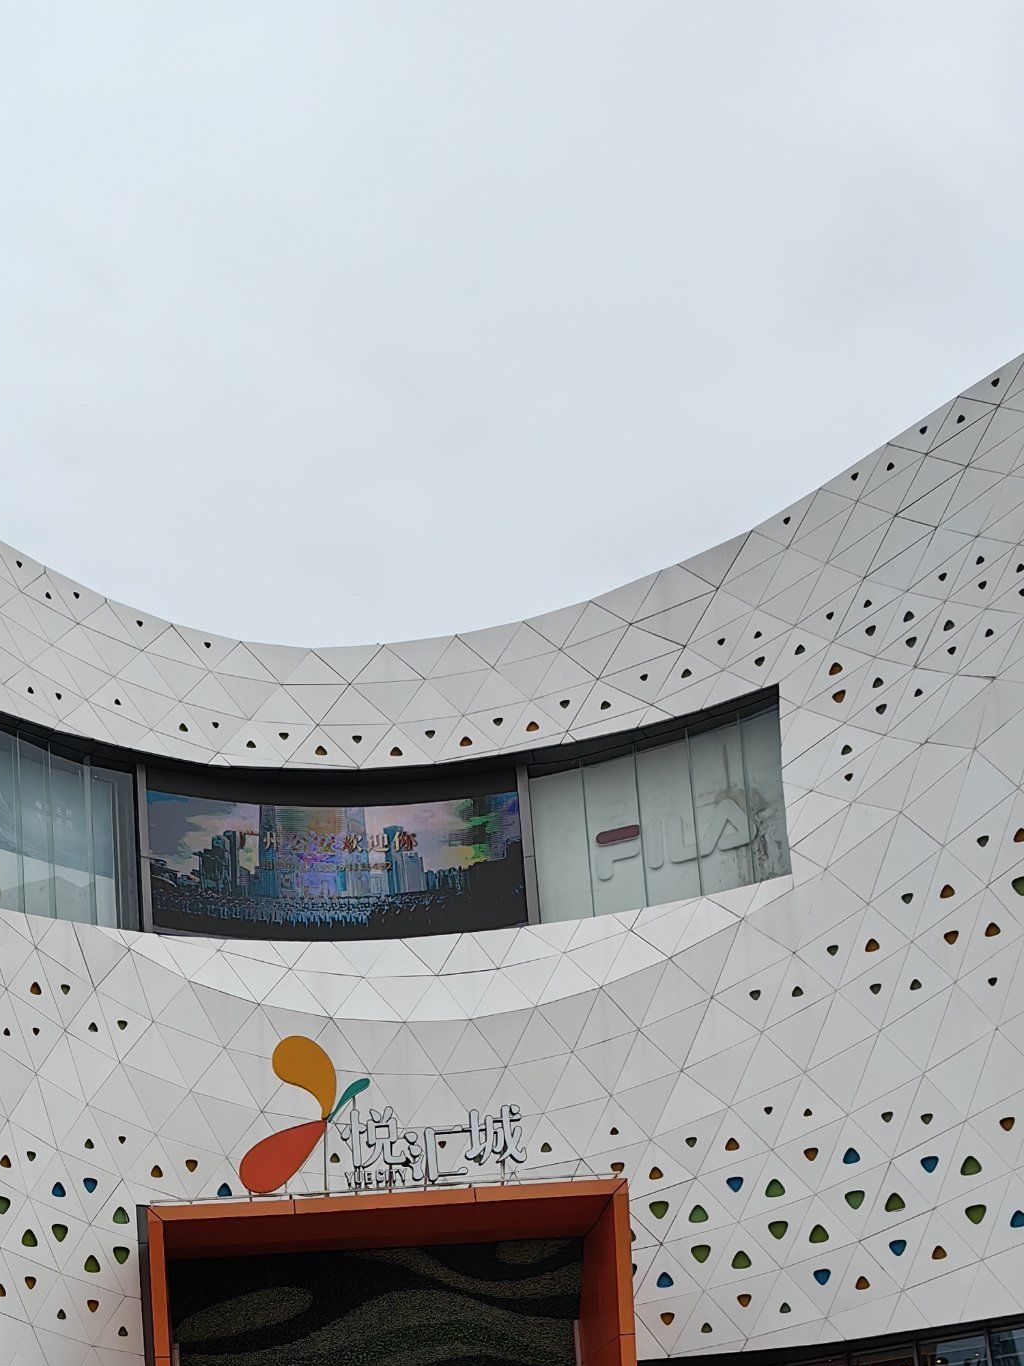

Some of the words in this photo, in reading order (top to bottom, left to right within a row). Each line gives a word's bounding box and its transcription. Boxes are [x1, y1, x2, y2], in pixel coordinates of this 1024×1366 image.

[595, 797, 758, 881] FILA
[341, 1104, 527, 1183] 悦汇城
[344, 1170, 372, 1187] YUE
[376, 1168, 407, 1185] CITY
